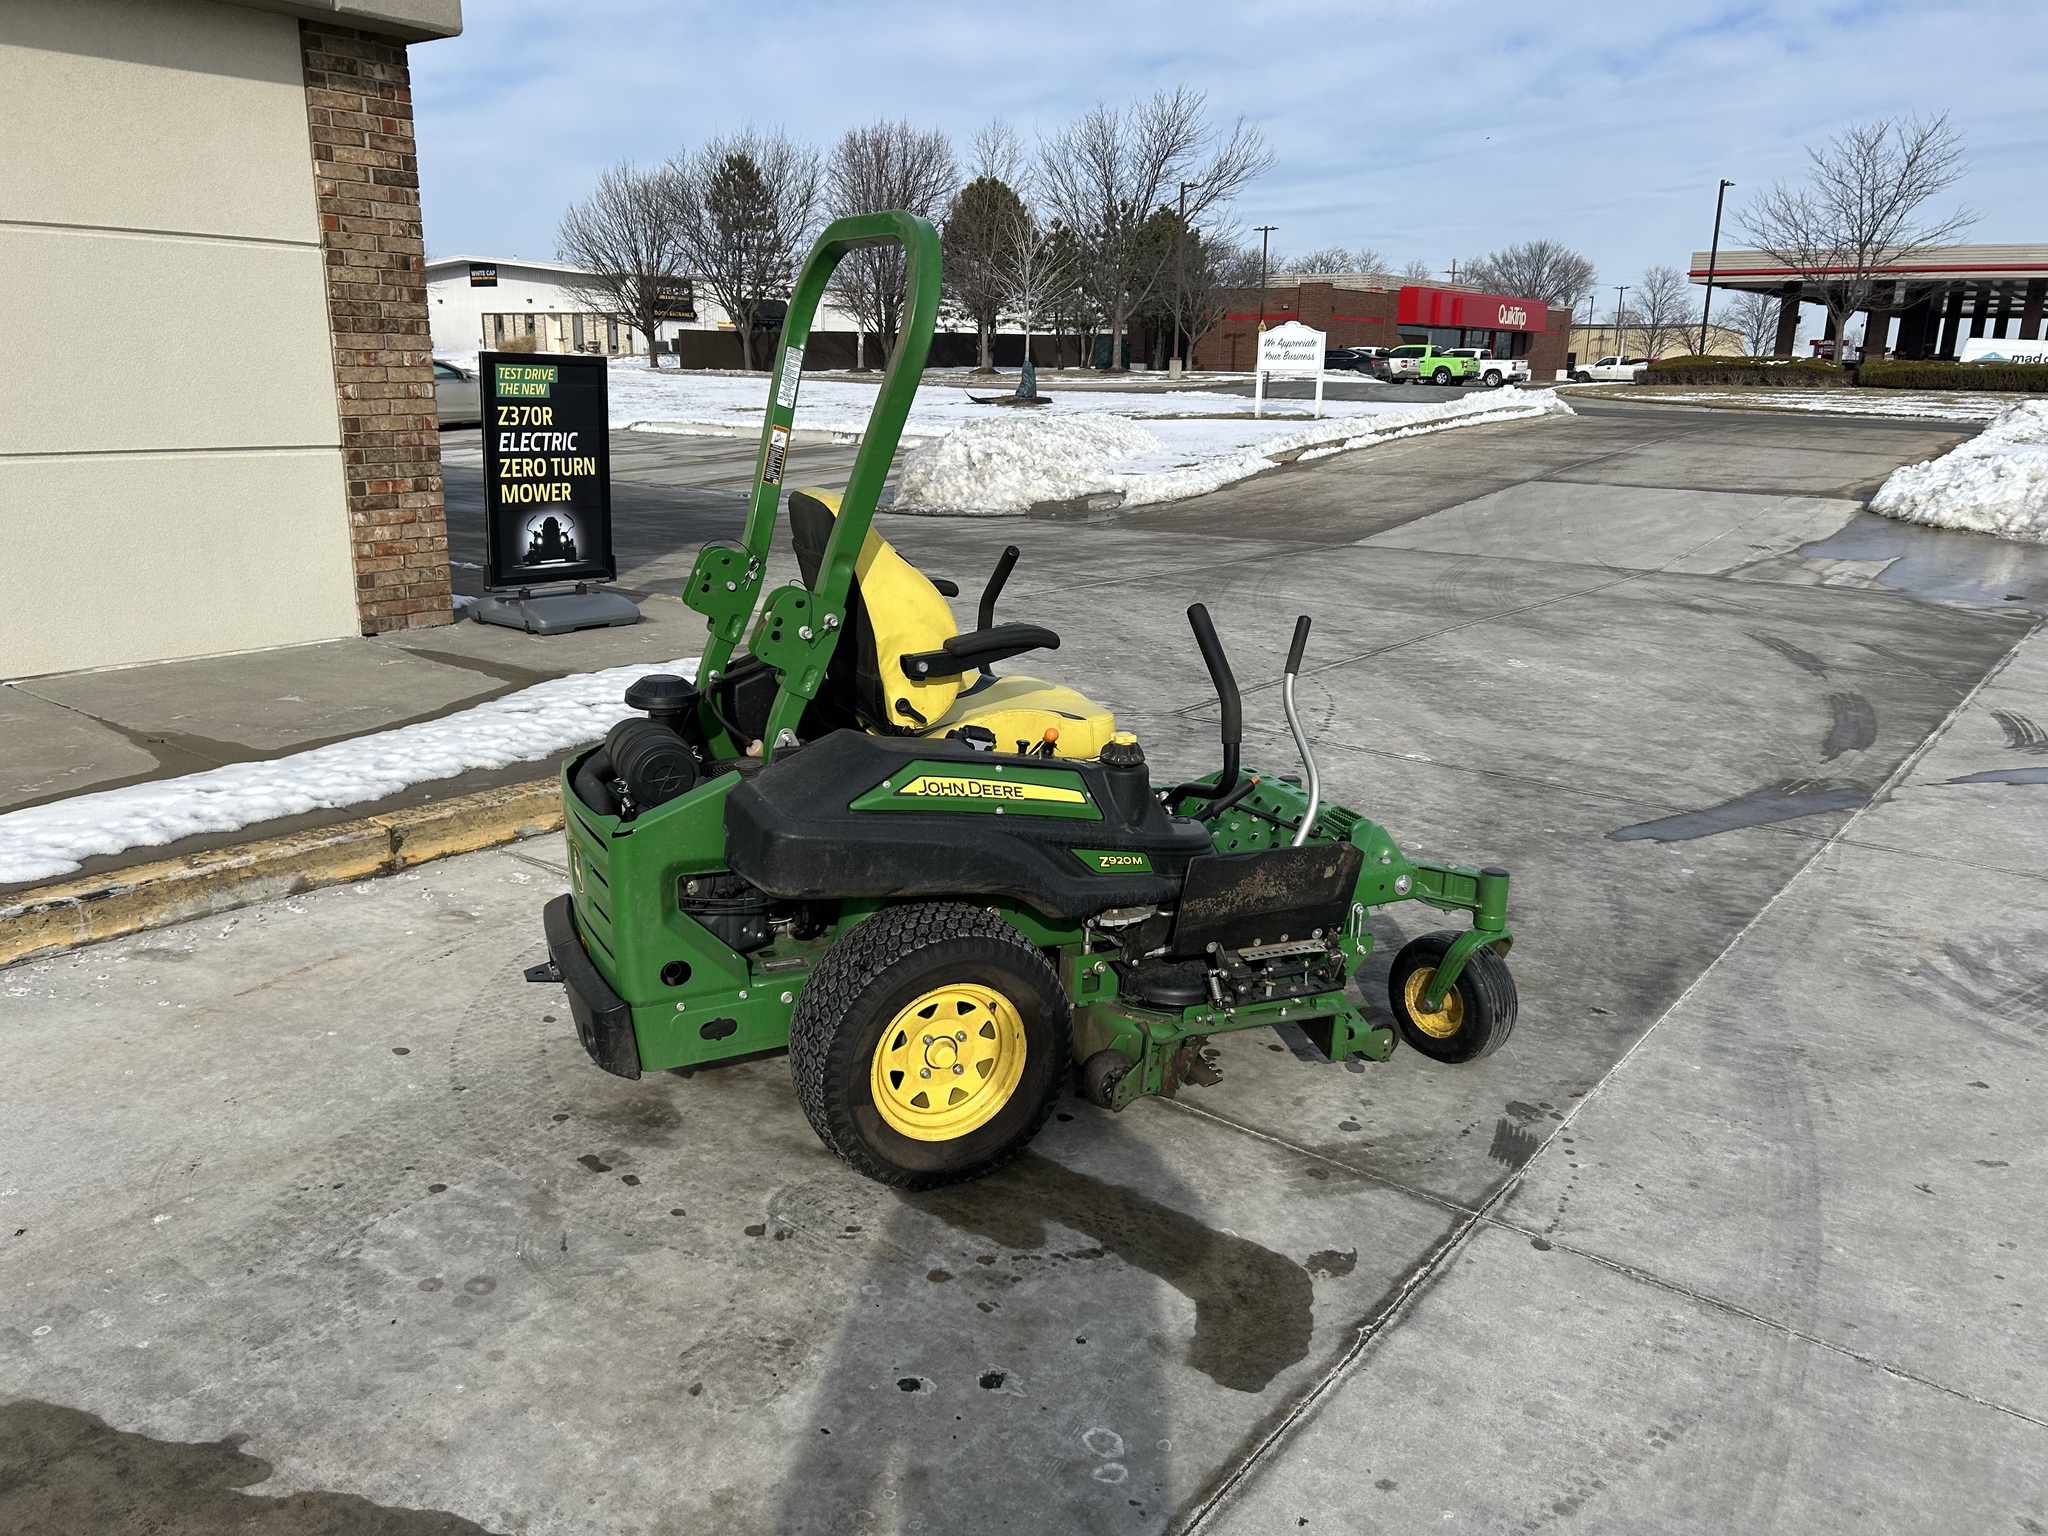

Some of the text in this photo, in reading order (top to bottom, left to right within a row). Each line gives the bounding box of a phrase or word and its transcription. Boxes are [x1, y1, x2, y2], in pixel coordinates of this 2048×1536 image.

[1498, 303, 1527, 330] QuikTrip
[1264, 337, 1318, 350] We Appreciate
[1264, 350, 1316, 361] Your Business
[499, 367, 555, 381] TEST DRIVE
[499, 382, 547, 396] THE NEW
[497, 405, 554, 426] Z370R
[498, 431, 579, 452] ELECTRIC
[499, 456, 596, 478] ZERO TURN
[501, 482, 572, 504] MOWER
[918, 779, 1024, 798] JOHN DEERE
[1098, 855, 1143, 868] Z920M
